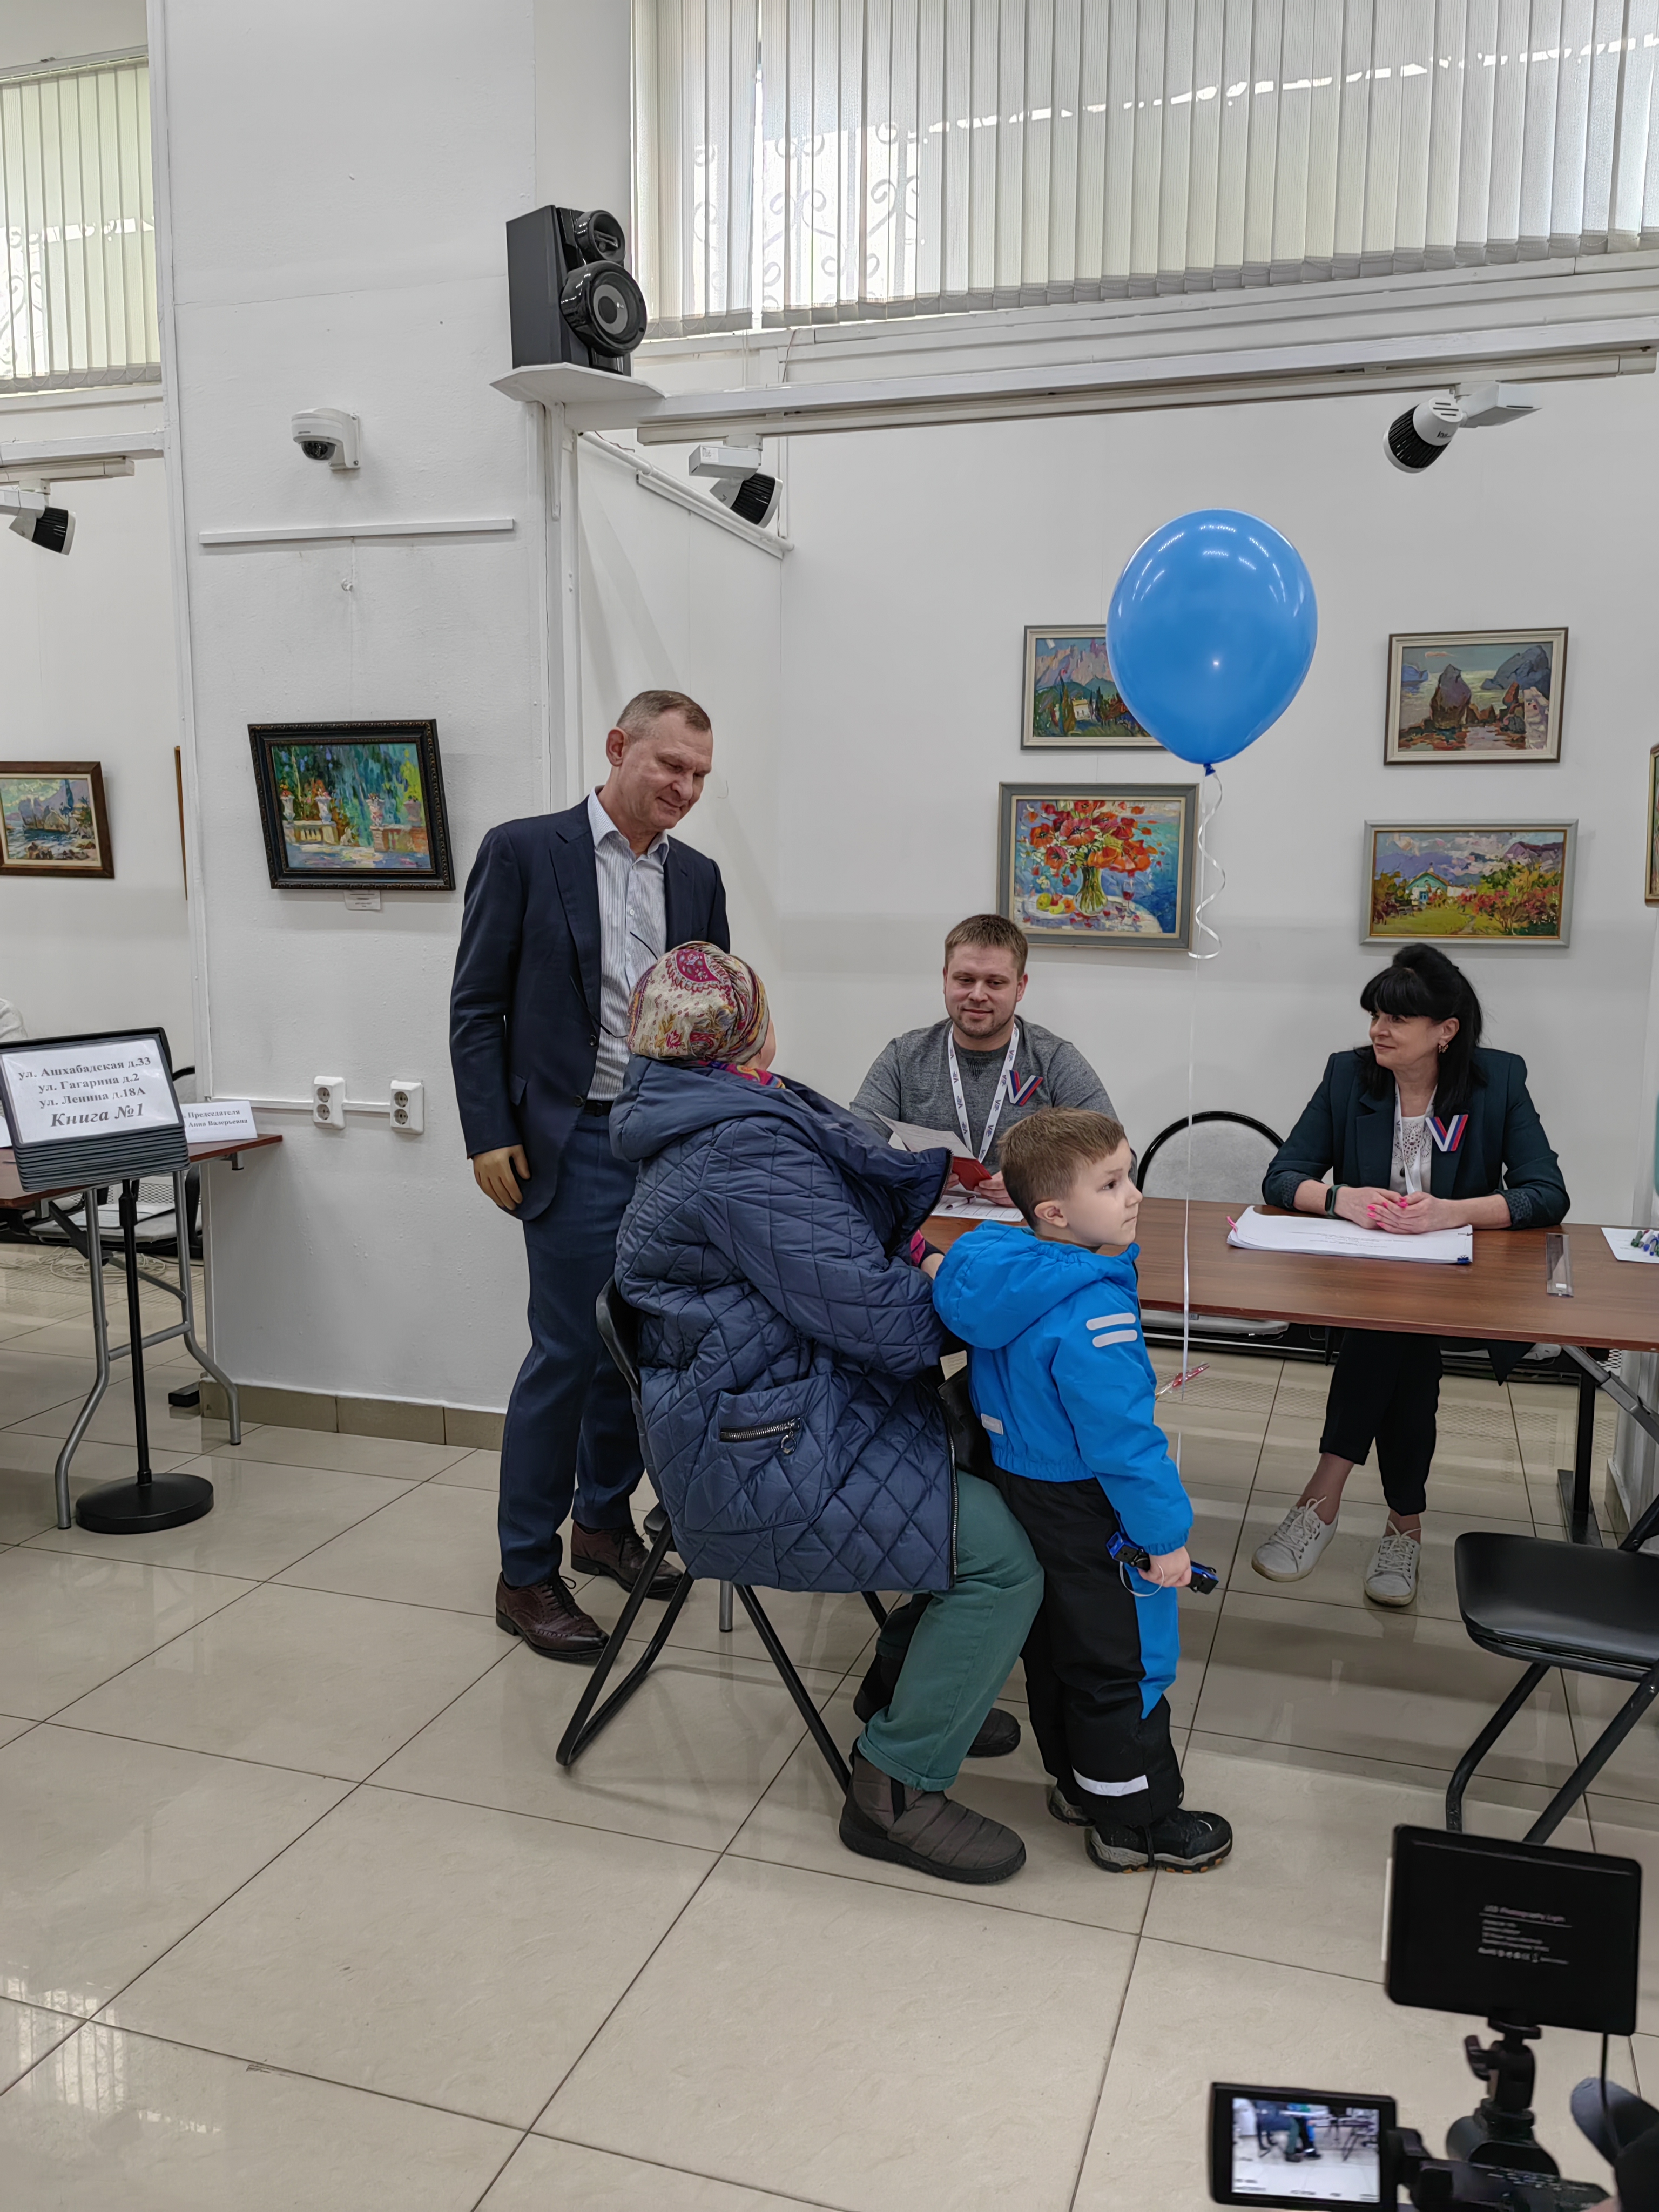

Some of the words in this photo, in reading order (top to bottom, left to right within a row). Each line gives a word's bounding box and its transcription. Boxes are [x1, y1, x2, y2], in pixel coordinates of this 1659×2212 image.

[18, 1071, 37, 1080] ул.
[41, 1062, 124, 1077] Ашхабадская
[127, 1057, 151, 1068] д.33
[38, 1085, 57, 1094] ул.
[60, 1077, 119, 1090] Гагарина
[123, 1073, 140, 1084] д.2
[39, 1100, 58, 1109] ул.
[62, 1092, 109, 1105] Ленина
[112, 1087, 146, 1100] д.18А
[50, 1111, 109, 1127] Книга
[114, 1103, 144, 1120] №1
[188, 1110, 240, 1119] Председателя
